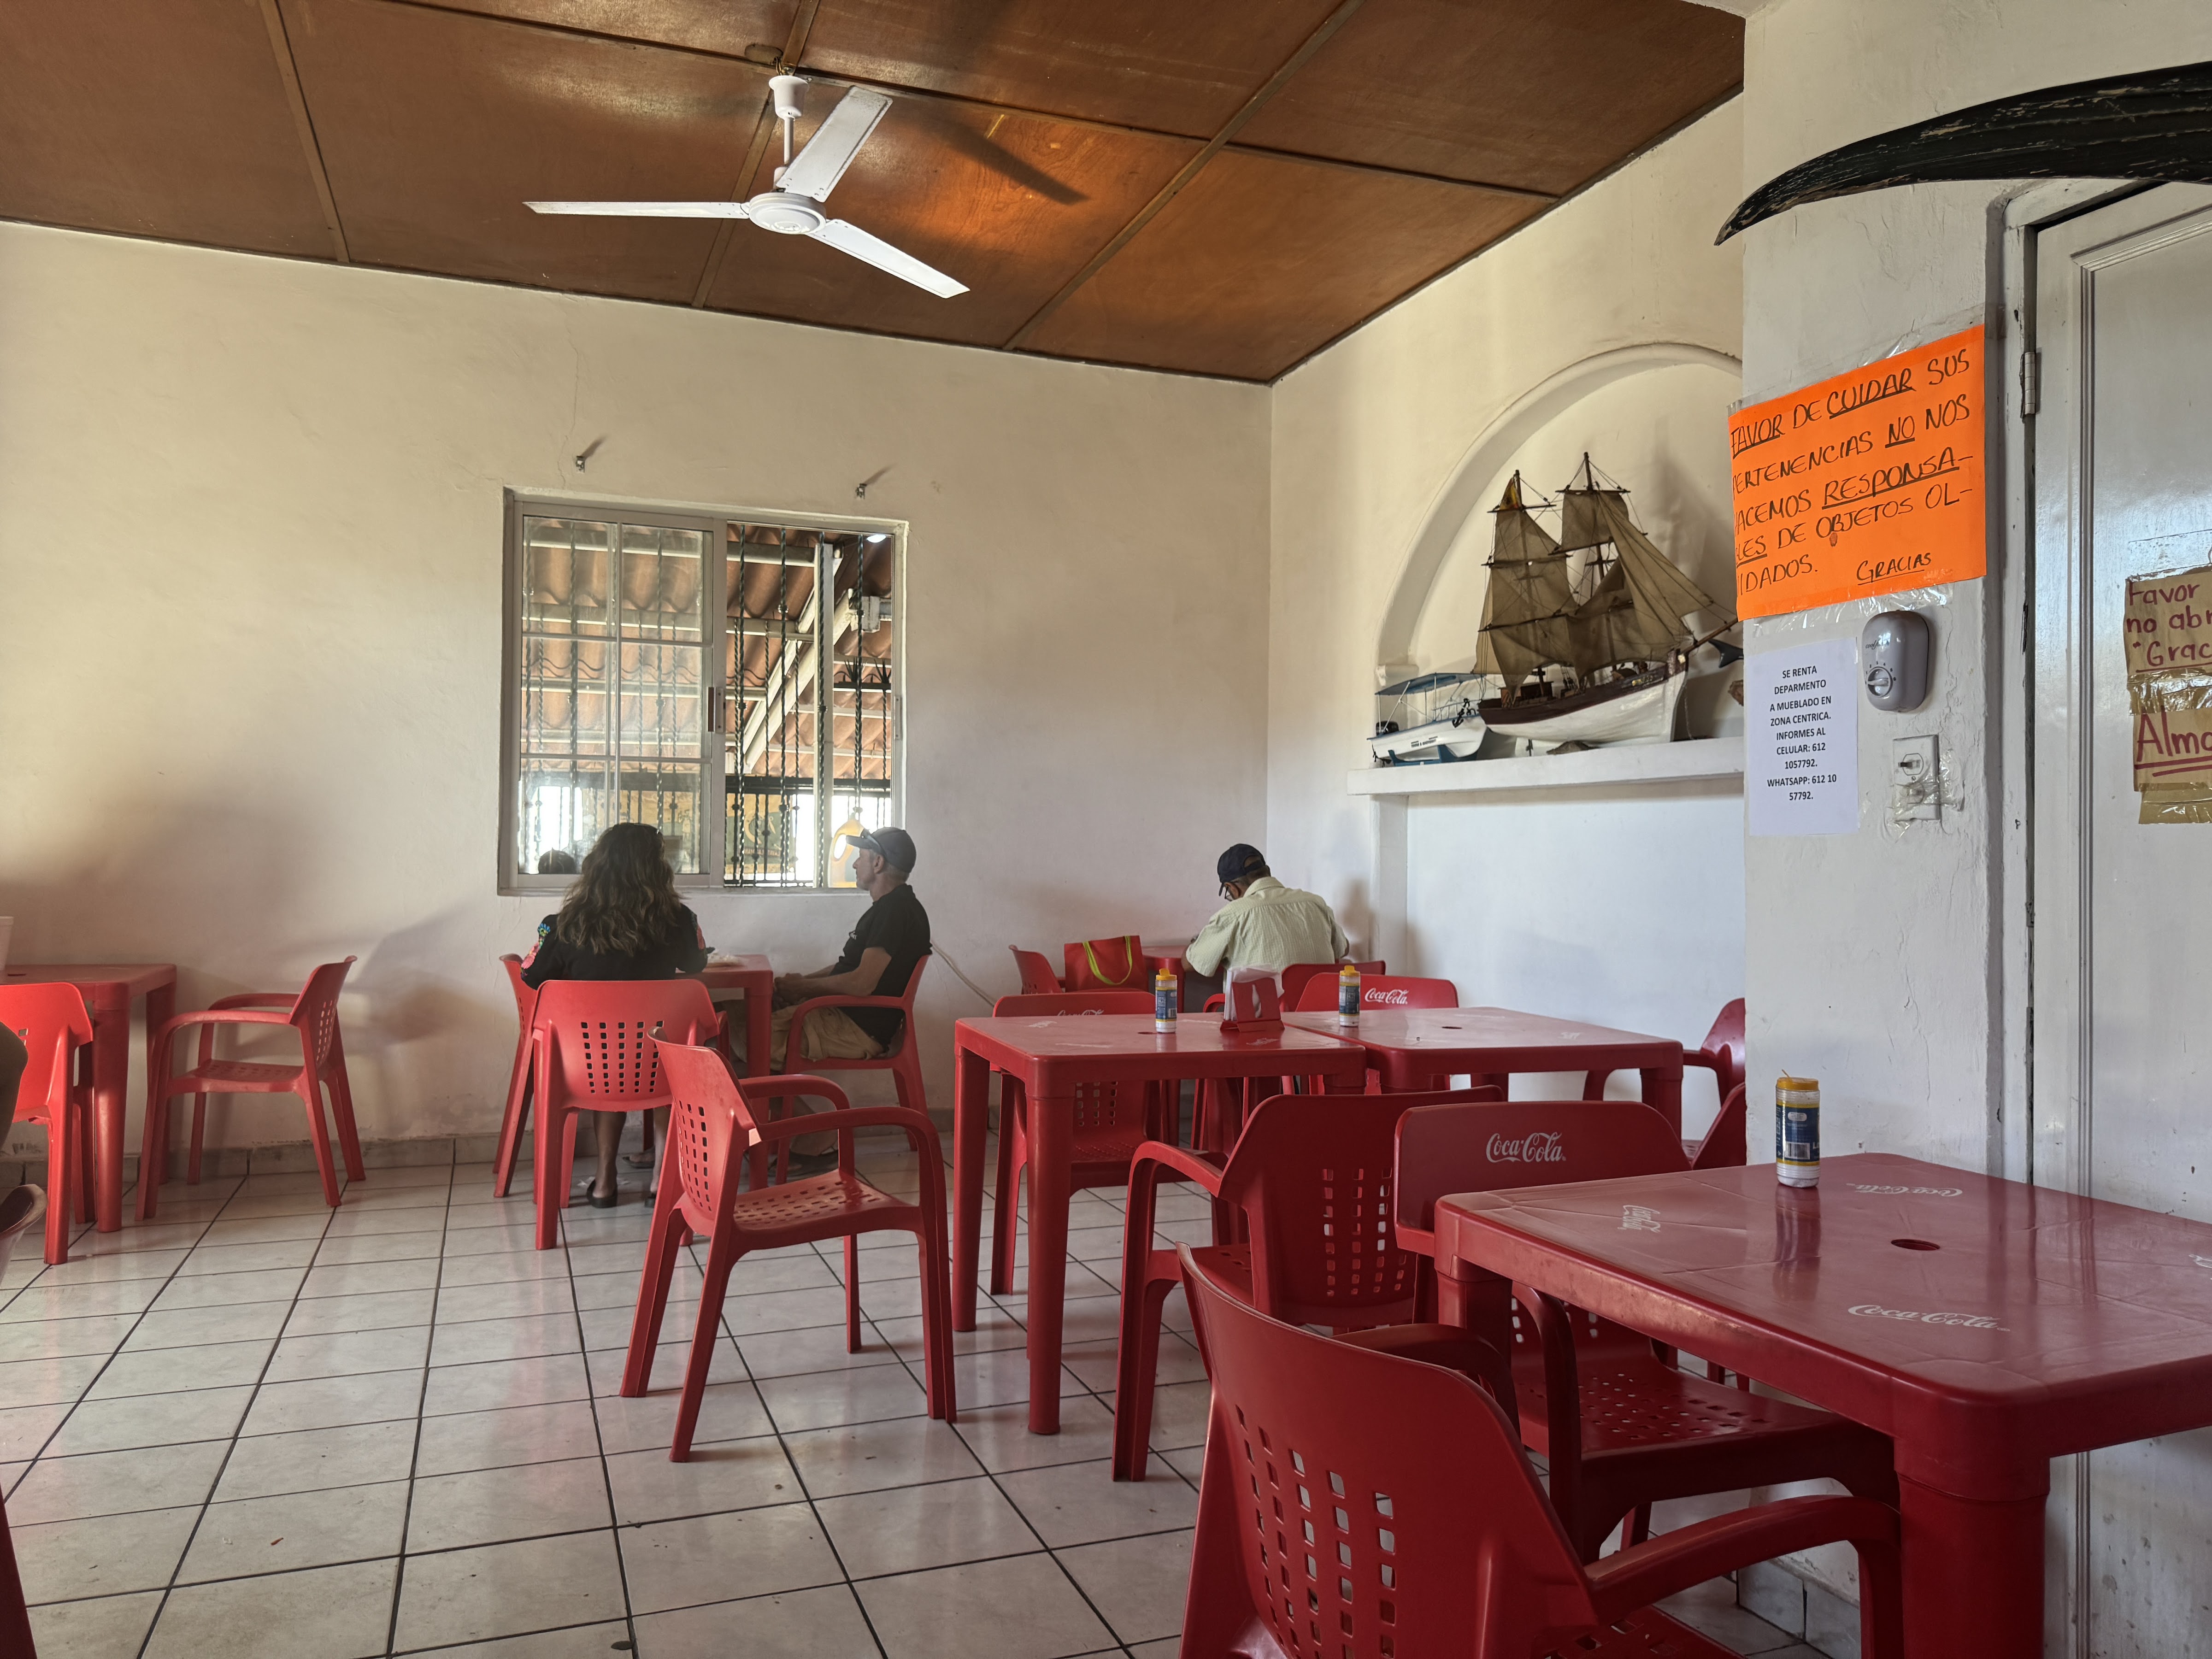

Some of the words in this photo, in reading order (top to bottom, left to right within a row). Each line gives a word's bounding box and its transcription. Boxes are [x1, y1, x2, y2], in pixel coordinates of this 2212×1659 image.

[1731, 414, 1785, 457] FAVOR
[1793, 400, 1822, 429] DE
[1827, 368, 1916, 417] CUIDAR
[1928, 349, 1969, 384] SUS
[1733, 431, 1872, 501] PERTENENCIAS
[1888, 416, 1915, 442] NO
[1926, 394, 1970, 429] NOS
[1824, 447, 1973, 506] RESPONSA-
[1736, 535, 1766, 561] LES
[1778, 523, 1806, 548] DE
[1816, 498, 1913, 538] OBJETOS
[1926, 483, 1972, 508] OL-
[2129, 581, 2200, 606] Favor
[2126, 618, 2157, 633] no
[1783, 670, 1790, 678] SE
[1793, 665, 1817, 677] RENTA
[1774, 679, 1826, 694] DEPARMENTO
[1770, 703, 1775, 712] A
[1777, 698, 1819, 711] MUEBLADO
[1821, 695, 1831, 705] EN
[1771, 716, 1791, 726] ZONA
[1793, 712, 1831, 724] CENTRICA.
[1777, 729, 1814, 740] INFORMES
[1816, 727, 1826, 736] AL
[1777, 744, 1810, 755] CELULAR:
[1812, 742, 1826, 752] 612
[1785, 759, 1818, 769] 1057792.
[1767, 777, 1810, 787] WHATSAPP:
[1812, 775, 1825, 783] 612
[1828, 774, 1836, 782] 10
[1789, 791, 1813, 800] 57792.
[1365, 988, 1409, 1005] Coca-Cola
[1486, 1132, 1563, 1163] Coca-Cola
[1848, 1305, 2001, 1329] Coca-Cola
